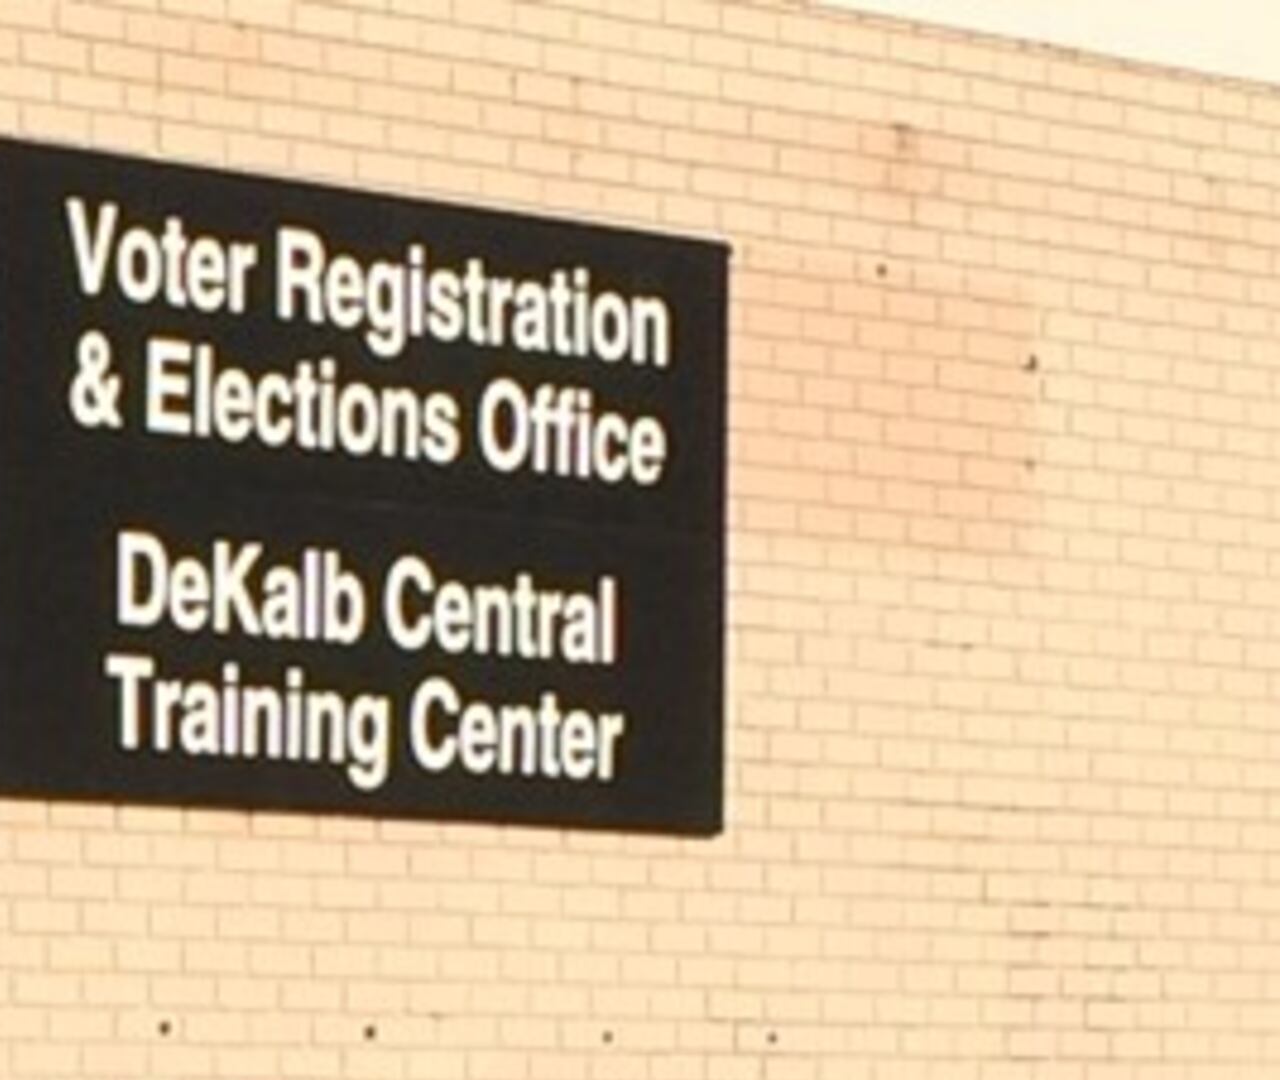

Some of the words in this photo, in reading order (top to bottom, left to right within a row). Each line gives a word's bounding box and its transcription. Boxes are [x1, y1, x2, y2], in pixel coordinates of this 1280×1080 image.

[65, 197, 258, 314] Voter
[276, 227, 671, 367] Registration
[69, 330, 123, 428] &
[145, 337, 461, 464] Elections
[477, 377, 668, 485] Office
[116, 530, 366, 645] DeKalb
[383, 555, 617, 665] Central
[104, 653, 391, 791] Training
[409, 676, 626, 781] Center
